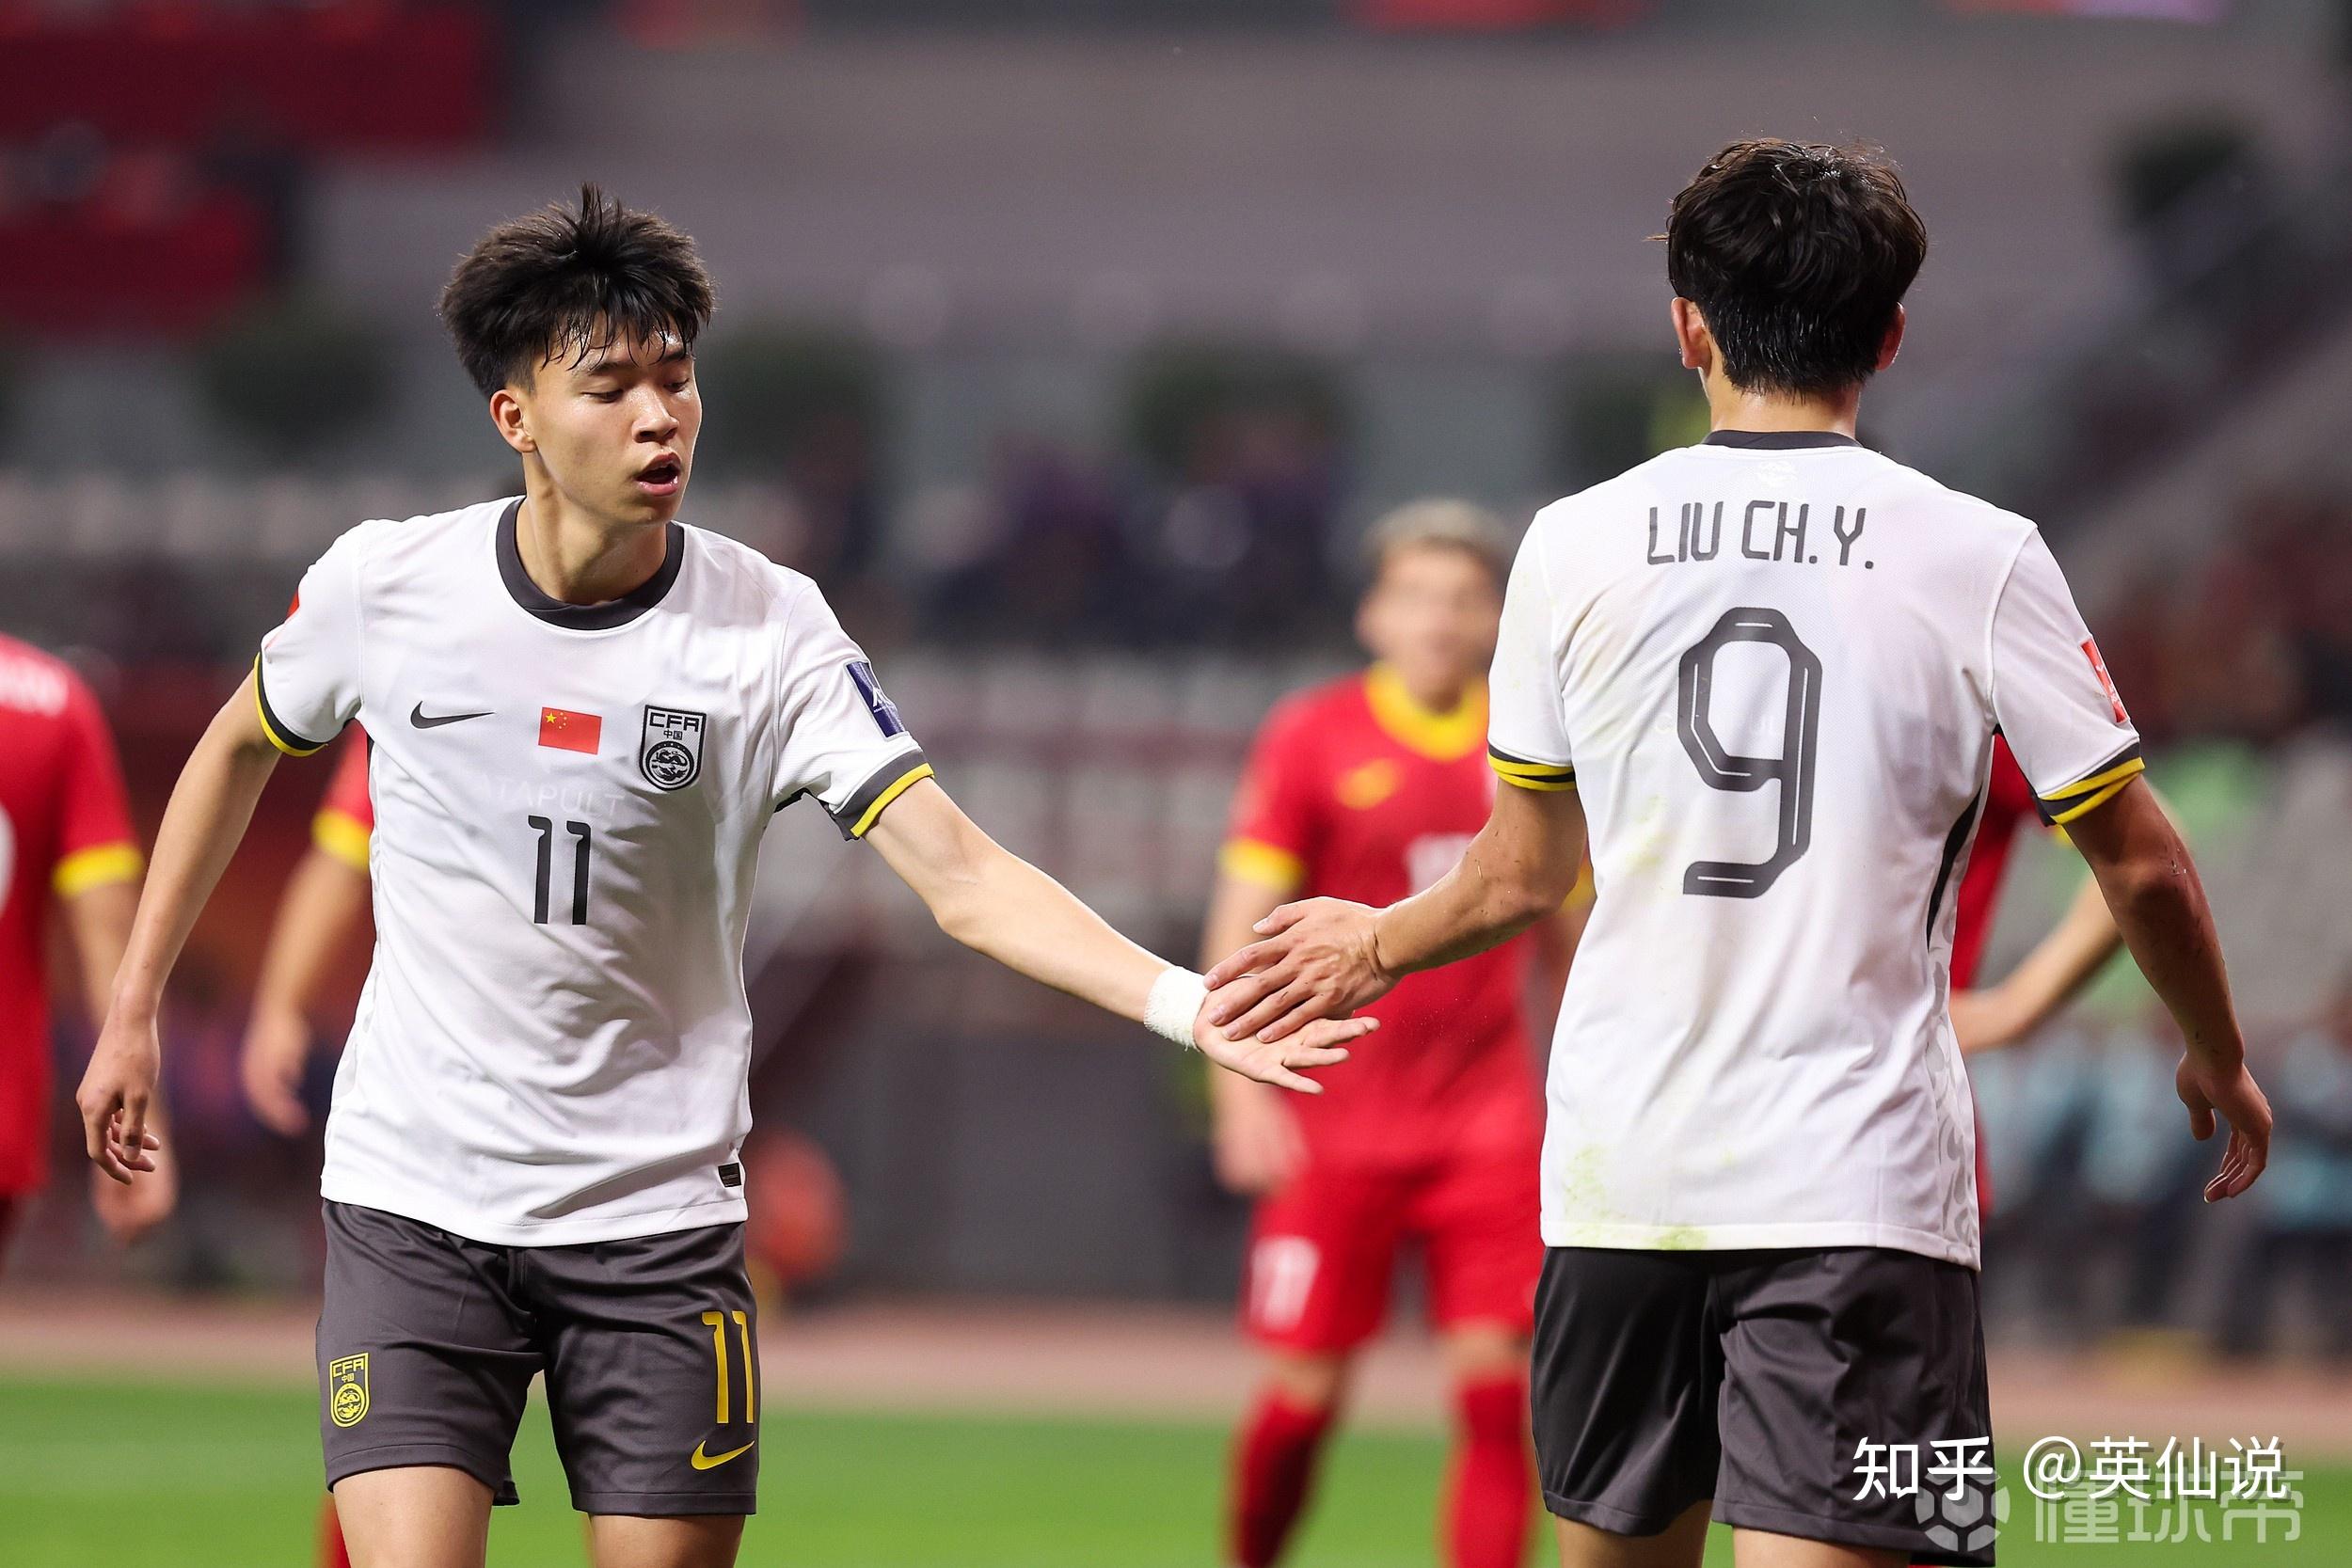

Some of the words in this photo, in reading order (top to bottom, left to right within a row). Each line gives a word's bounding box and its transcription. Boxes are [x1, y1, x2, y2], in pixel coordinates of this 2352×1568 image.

[1647, 500, 1724, 564] LIU
[649, 712, 700, 733] CFA
[663, 729, 683, 741] 中国
[1677, 607, 1822, 898] 9
[528, 815, 591, 926] 11
[332, 1357, 364, 1378] CFA
[701, 1310, 755, 1424] 11
